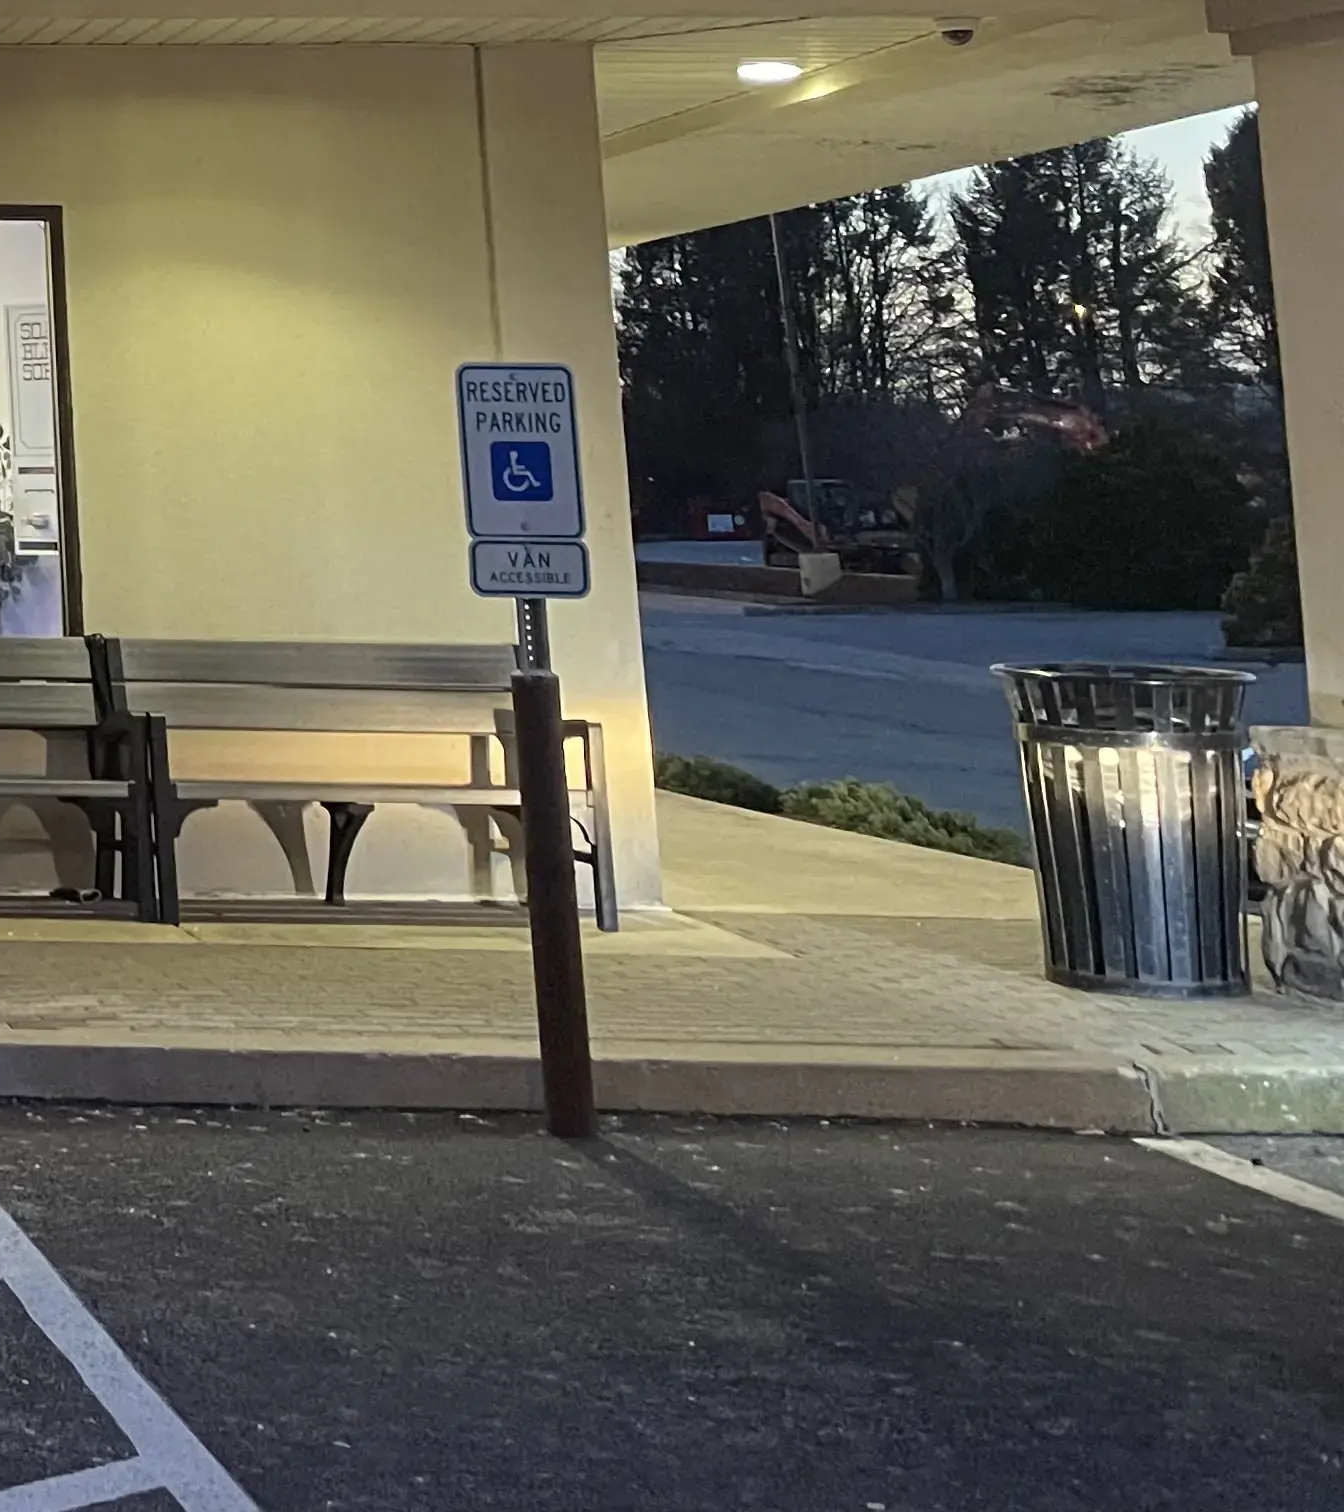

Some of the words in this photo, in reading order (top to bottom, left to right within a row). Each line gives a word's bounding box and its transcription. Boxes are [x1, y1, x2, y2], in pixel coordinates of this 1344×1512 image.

[466, 381, 566, 403] RESERVED
[476, 412, 561, 434] PARKING
[508, 551, 551, 568] VAN
[490, 572, 572, 585] ACCESSIBLE
